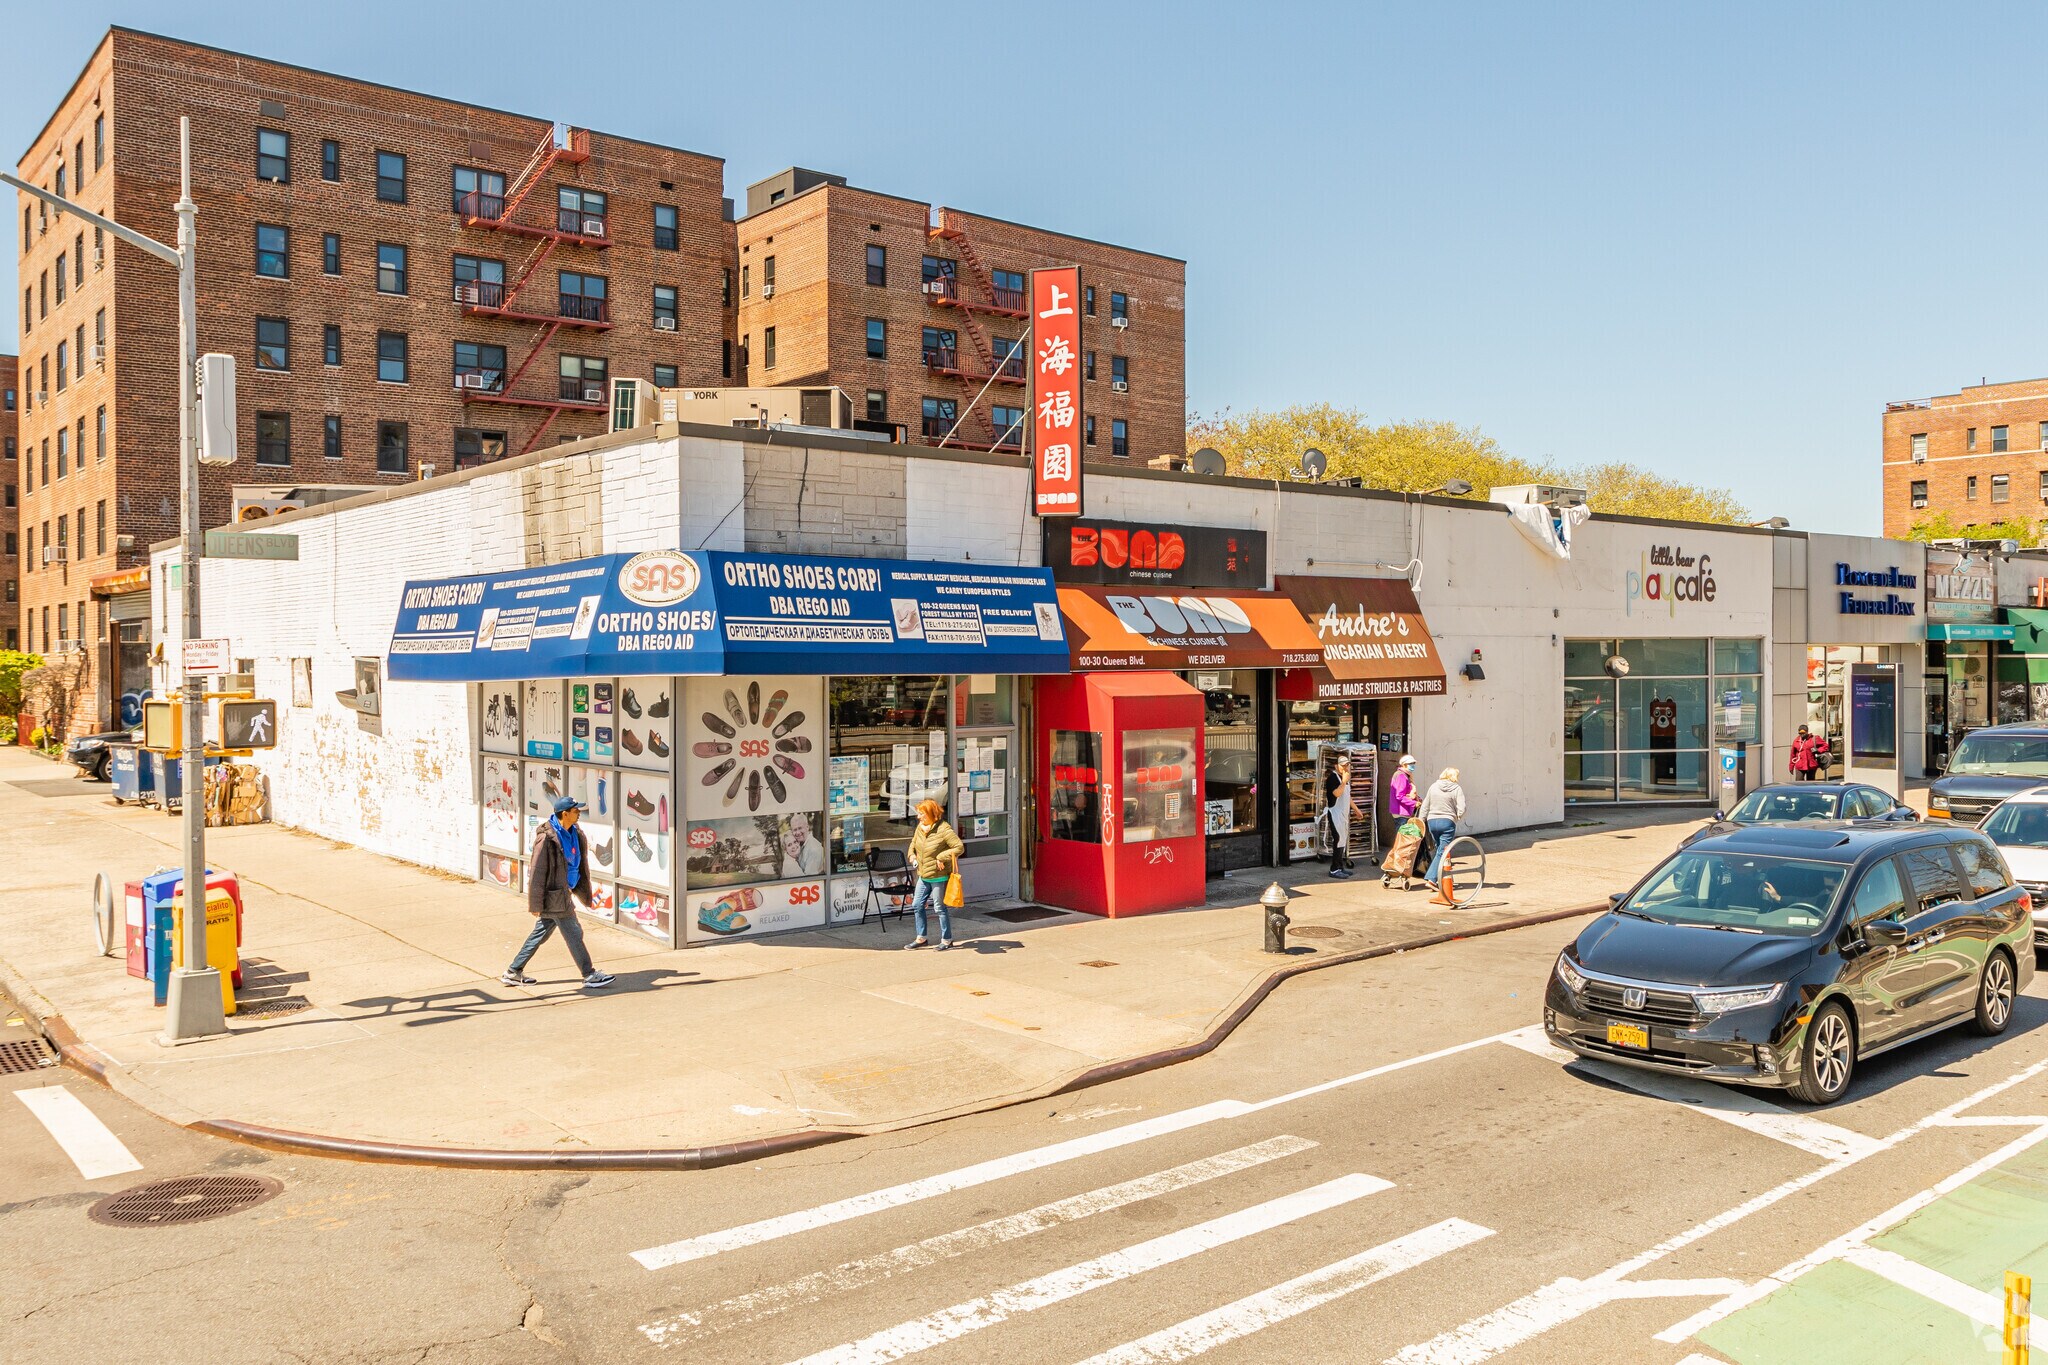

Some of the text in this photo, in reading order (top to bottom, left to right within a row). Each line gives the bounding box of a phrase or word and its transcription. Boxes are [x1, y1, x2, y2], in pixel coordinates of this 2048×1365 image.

[208, 536, 295, 555] QUEENS BLVD
[1651, 545, 1695, 567] little bear
[632, 564, 686, 594] SAS
[724, 562, 780, 588] ORTHO
[783, 564, 836, 590] SHOES
[1935, 575, 1993, 600] MEZZE
[405, 587, 432, 609] ORTHO
[431, 584, 459, 607] SHOES
[770, 596, 850, 616] DBA REGO AID
[429, 614, 447, 630] REGO
[598, 611, 653, 633] ORTHO
[1318, 603, 1409, 640] Andre's
[730, 625, 889, 640] ОРТОПЕДИЧЕСКАЯ И ДИАБЕТИЧЕСКАЯ ОБУВЬ
[618, 634, 694, 651] DBA REGO AID
[1188, 655, 1225, 664] WE DELIVER
[1283, 654, 1319, 662] 718.275.8000
[1322, 643, 1427, 660] UNGARIAN BAKERY
[1079, 656, 1145, 665] 100-30 Queens Blvd.
[1319, 680, 1442, 696] HOME MADE STRUDELS & PASTRIES
[740, 740, 770, 758] SAS
[169, 797, 182, 806] 2Y
[690, 830, 714, 845] SAS
[789, 885, 820, 905] SAS
[207, 902, 228, 912] cialito
[206, 917, 230, 925] RATIS
[760, 914, 790, 924] RELAXED
